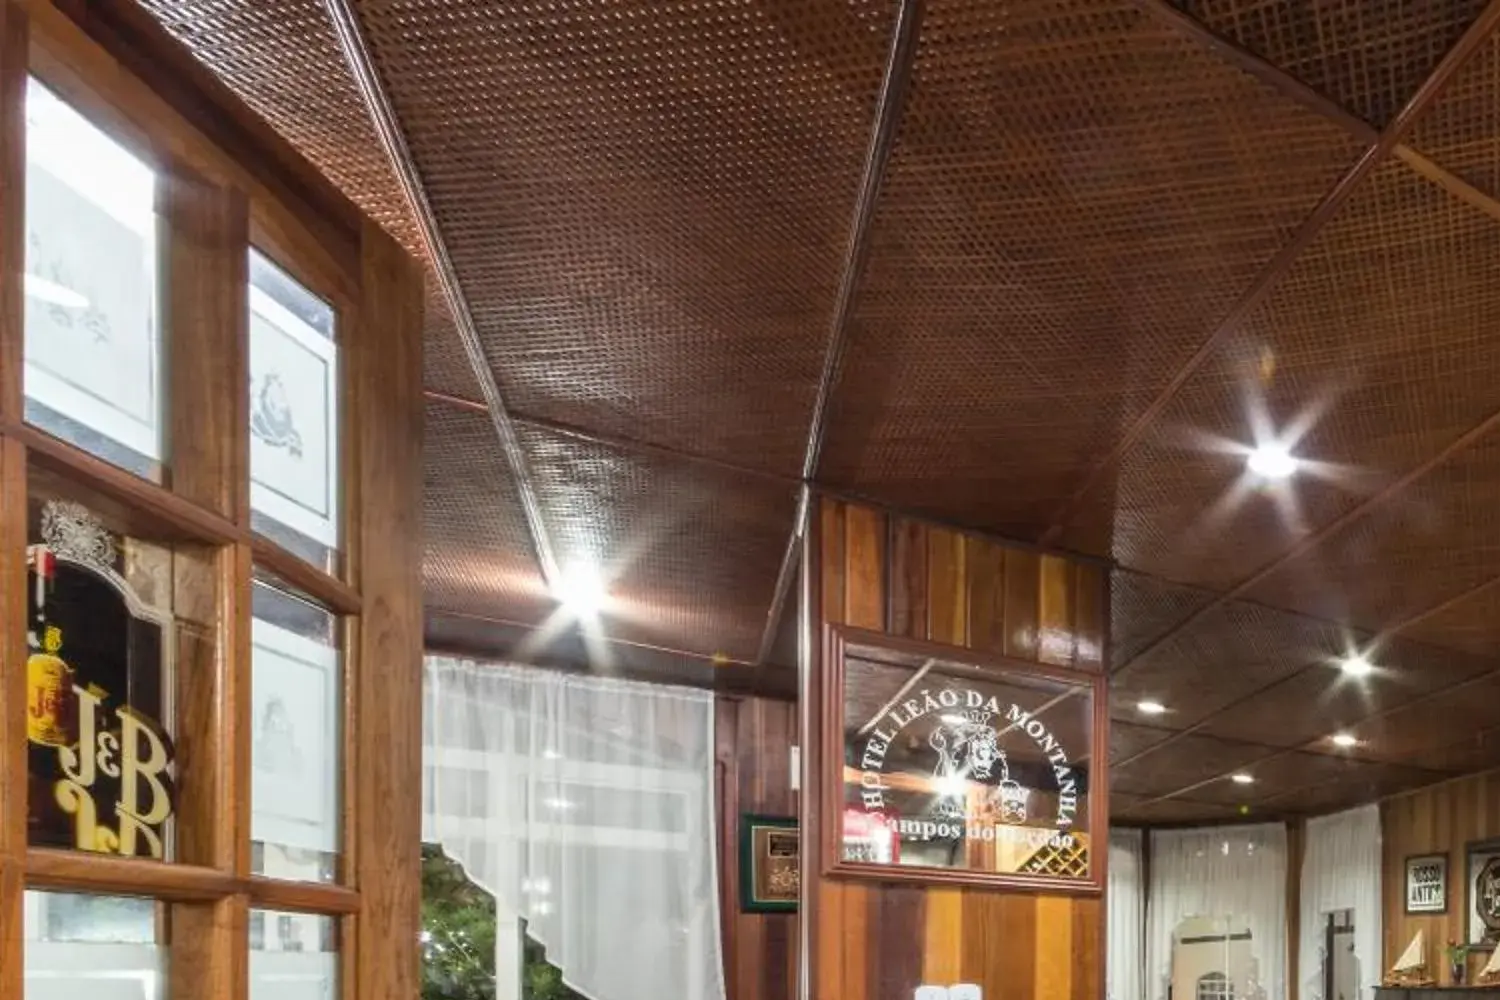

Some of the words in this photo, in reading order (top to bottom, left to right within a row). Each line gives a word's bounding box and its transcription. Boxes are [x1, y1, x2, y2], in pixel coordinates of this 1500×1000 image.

[58, 683, 171, 826] J&B
[862, 725, 898, 810] HOTEL
[889, 688, 958, 729] LEÃO
[966, 689, 1000, 714] DA
[870, 813, 961, 842] ampos
